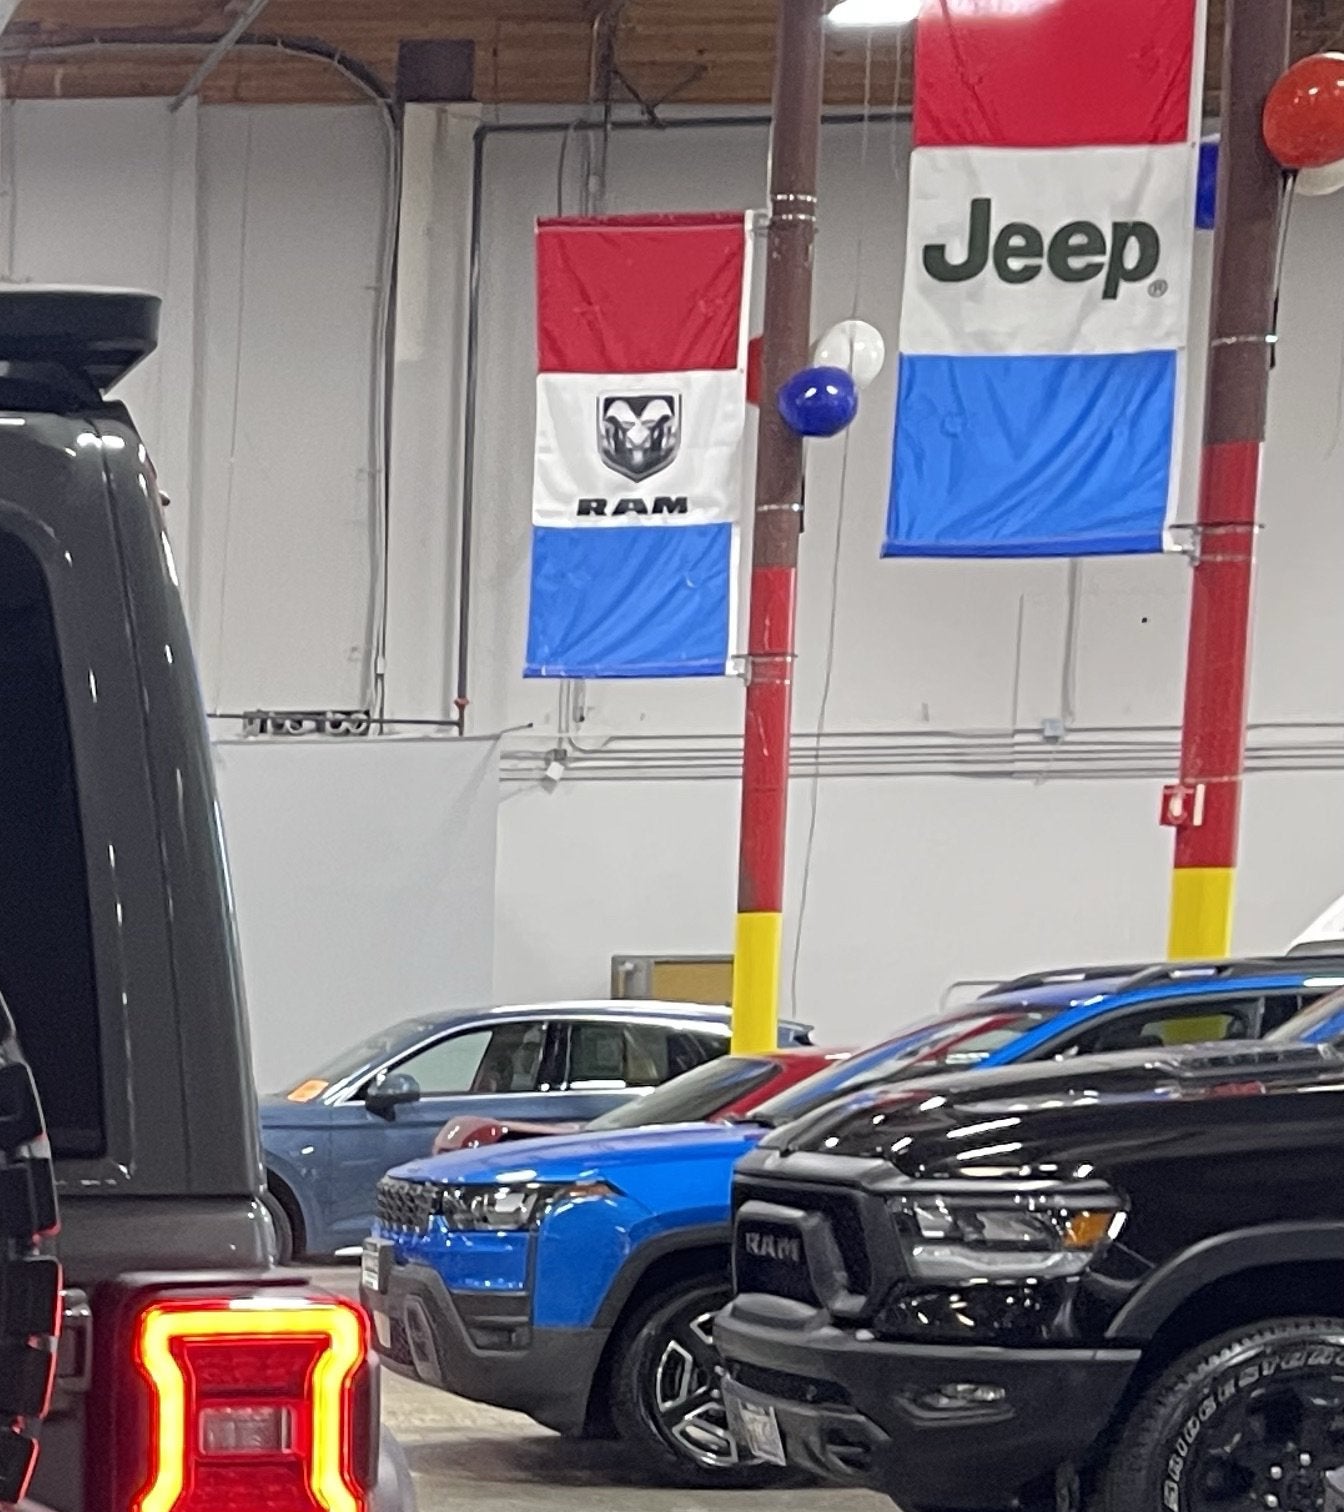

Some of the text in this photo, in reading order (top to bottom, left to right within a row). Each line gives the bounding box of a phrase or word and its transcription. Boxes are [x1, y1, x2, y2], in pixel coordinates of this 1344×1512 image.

[921, 198, 1161, 300] Jeep
[576, 496, 689, 517] RAM
[745, 1232, 800, 1262] RAM
